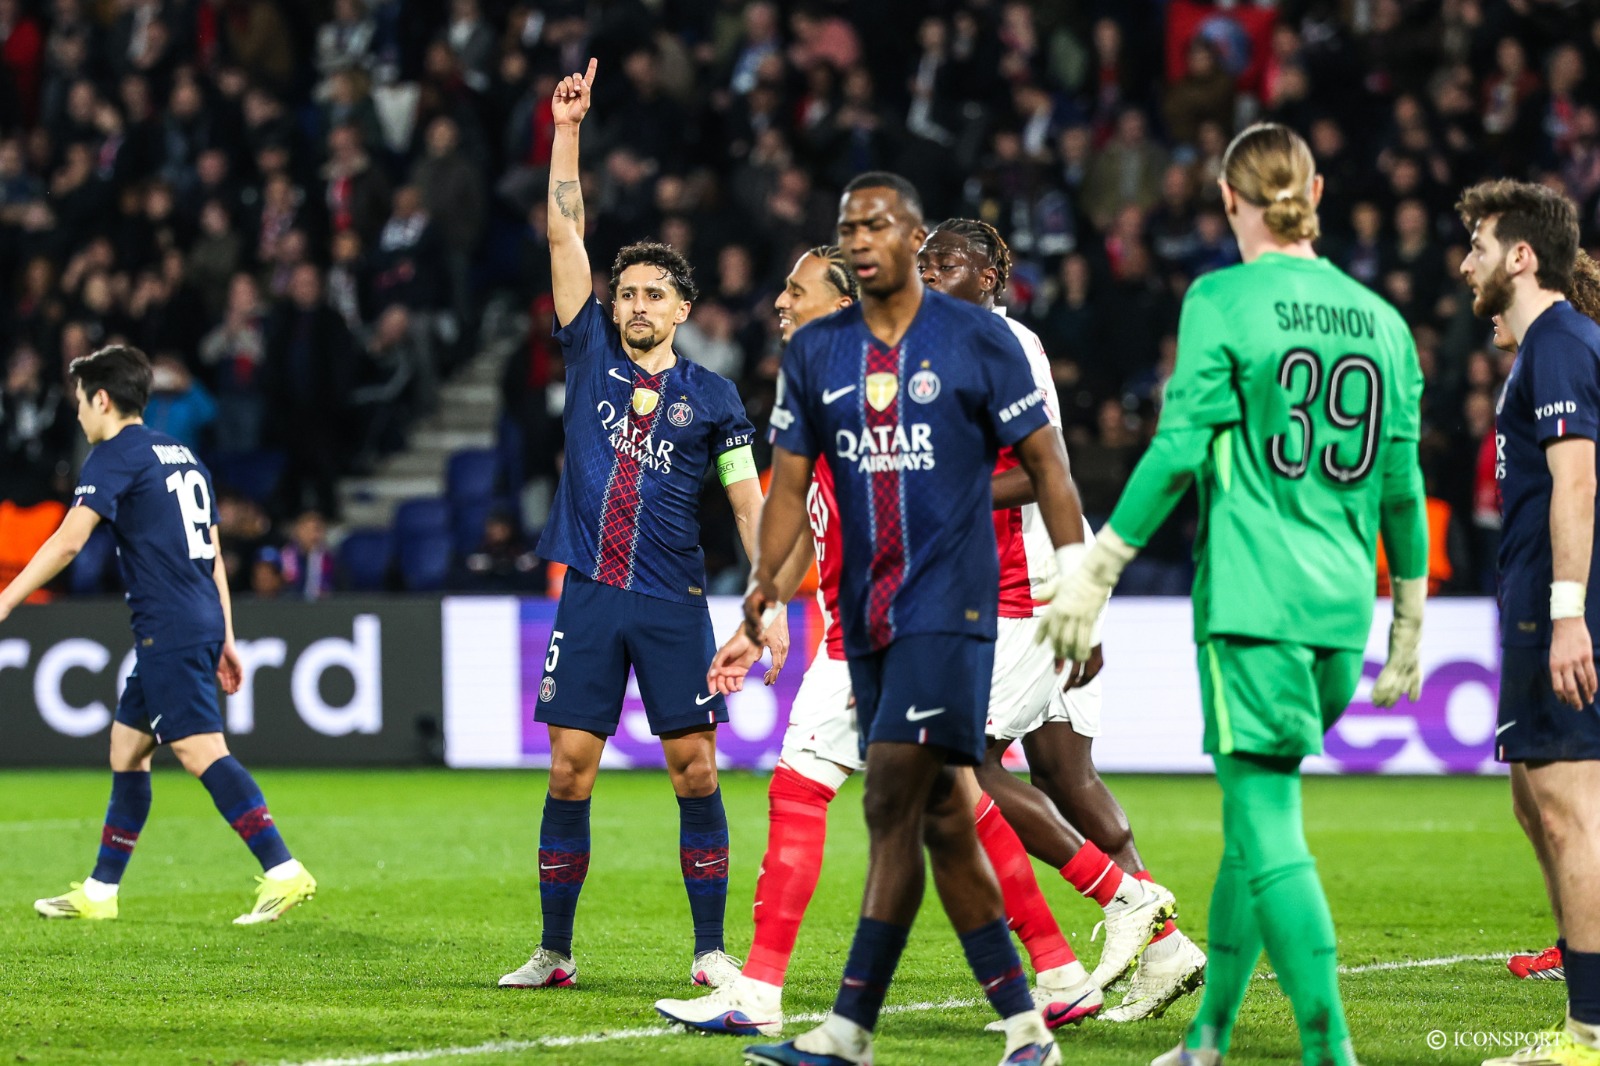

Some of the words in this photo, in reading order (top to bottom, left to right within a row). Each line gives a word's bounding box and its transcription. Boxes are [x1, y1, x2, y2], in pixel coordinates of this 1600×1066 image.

[1274, 302, 1375, 339] SAFONOV
[597, 400, 674, 462] QATAR
[1267, 347, 1384, 485] 39
[608, 433, 672, 475] AIRWAYS
[836, 423, 934, 462] QATAR
[857, 452, 936, 474] AIRWAYS
[165, 469, 217, 560] 19
[545, 630, 565, 673] 5
